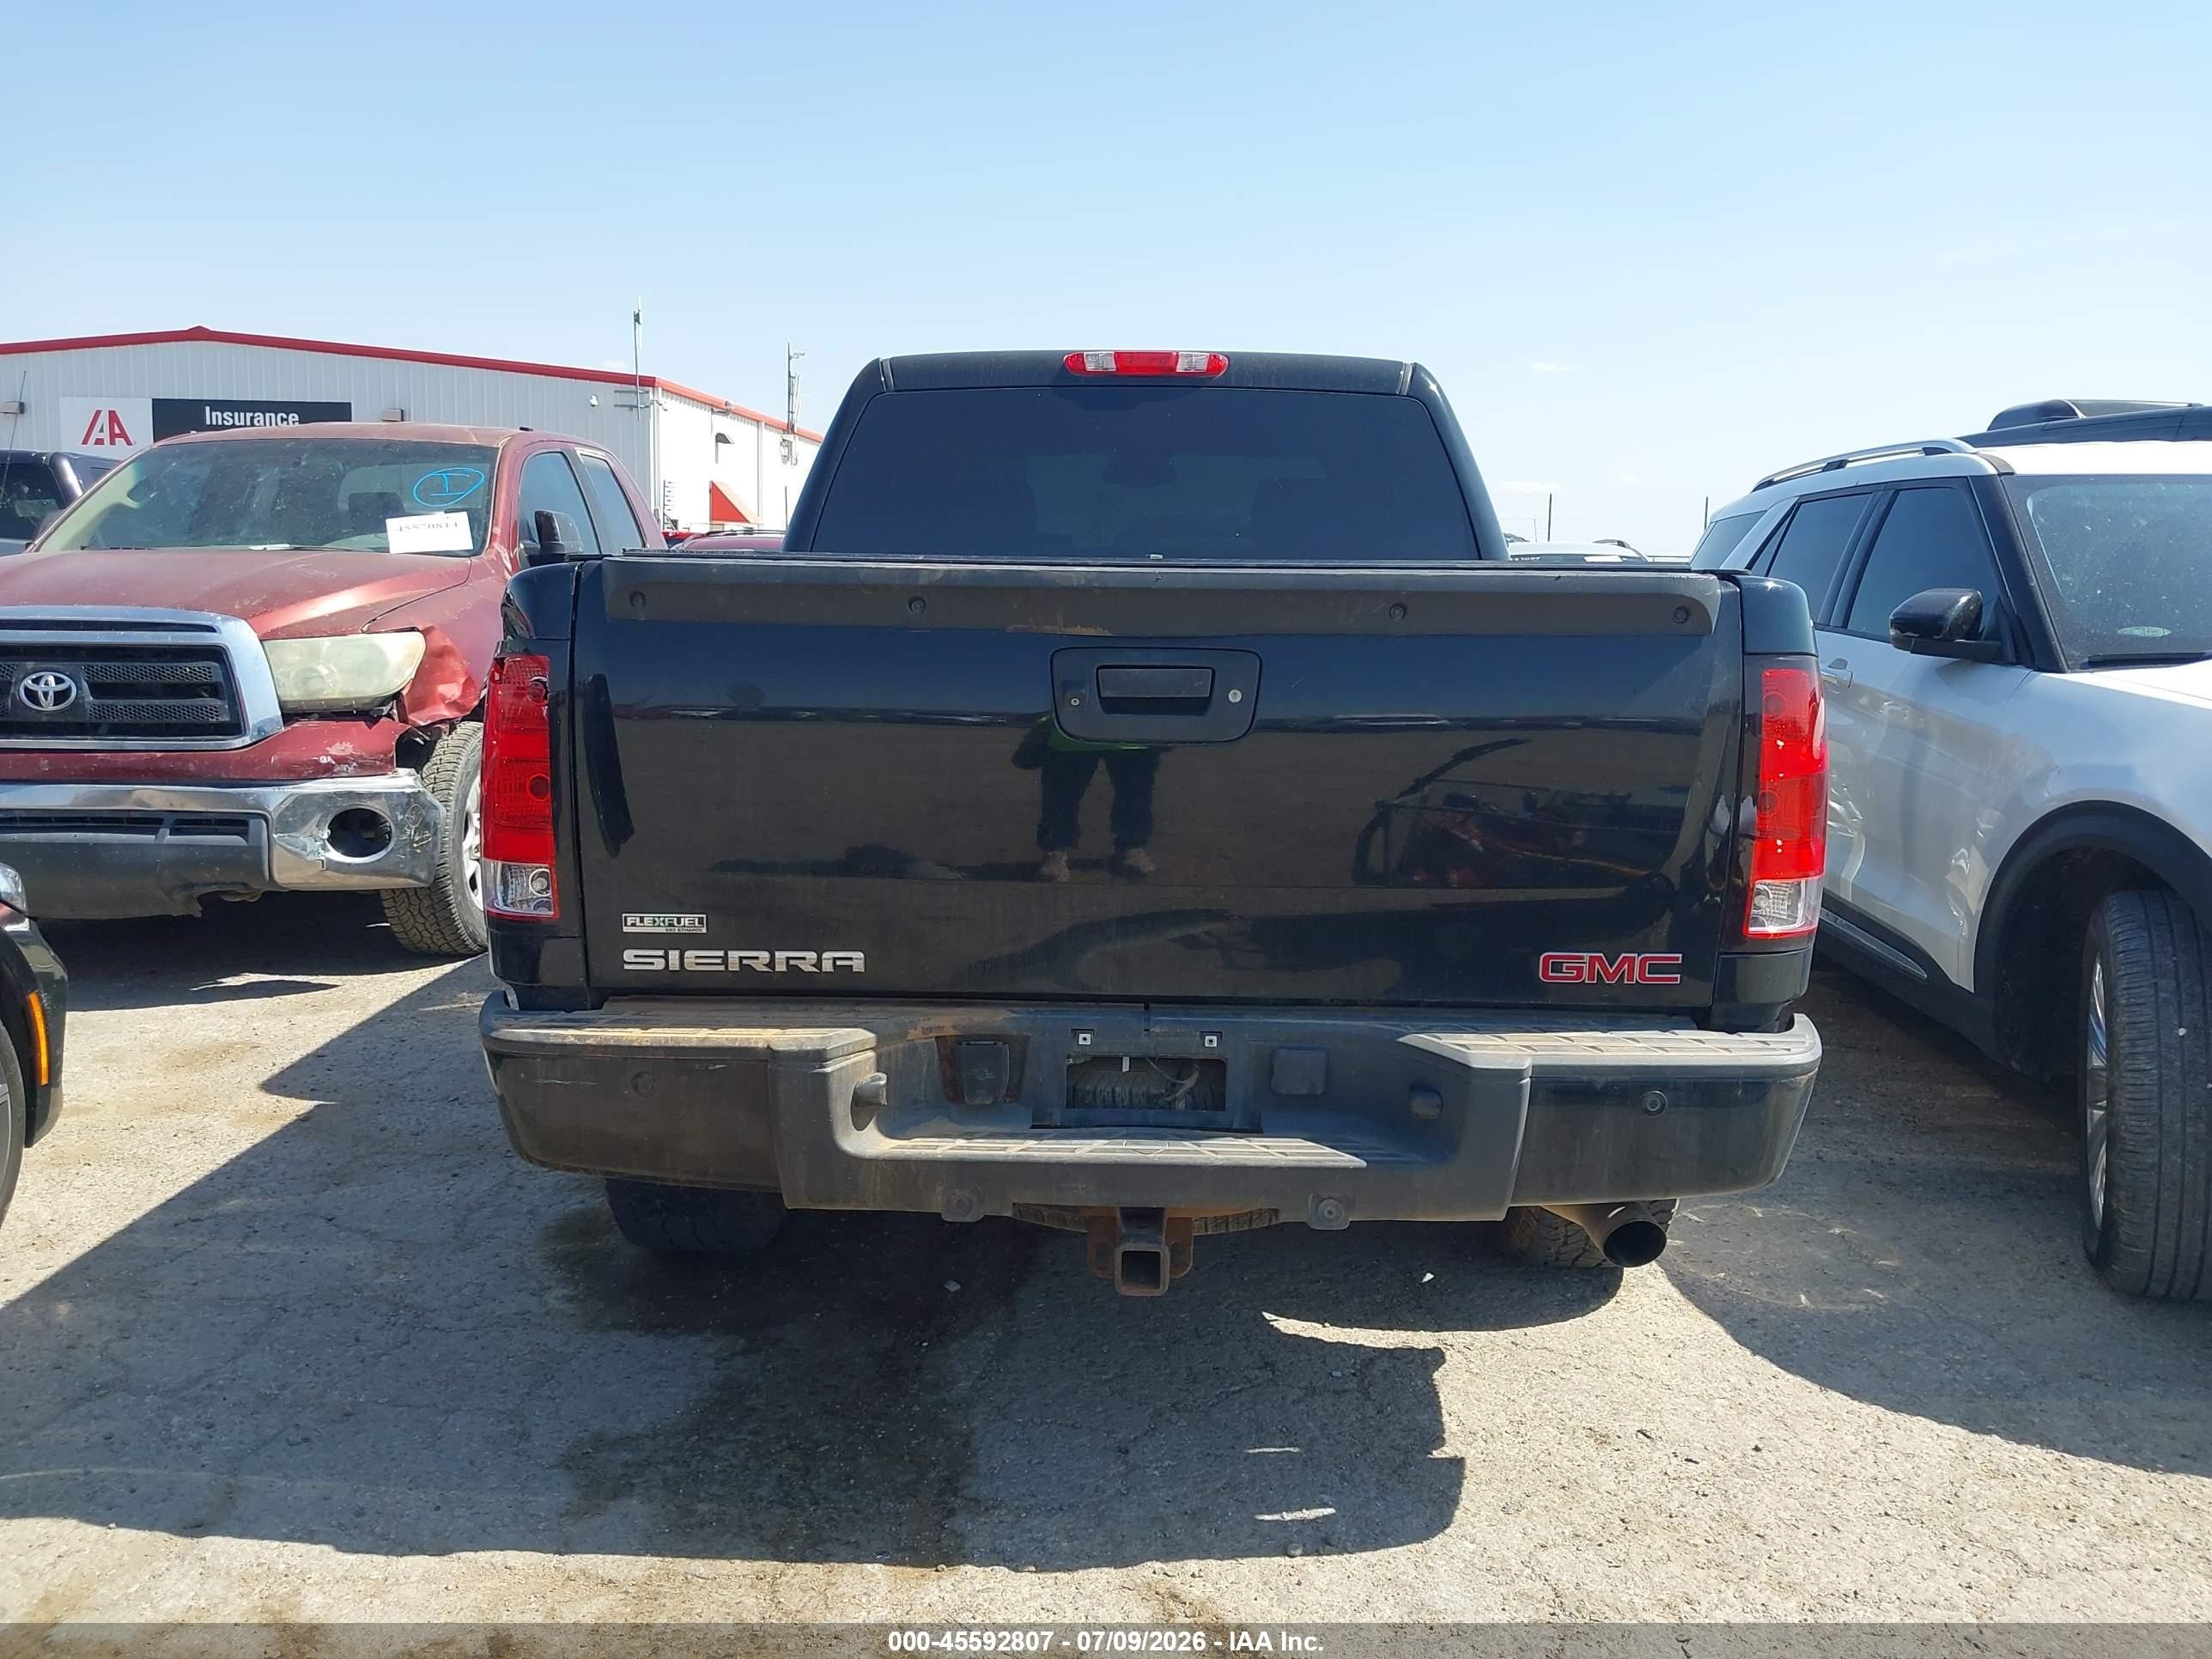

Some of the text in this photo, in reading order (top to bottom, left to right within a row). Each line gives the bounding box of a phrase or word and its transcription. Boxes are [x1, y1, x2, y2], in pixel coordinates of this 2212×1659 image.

[205, 406, 300, 427] Insurance
[625, 916, 703, 927] FLEXFUEL
[623, 949, 865, 972] SIERRA
[1540, 952, 1682, 984] GMC
